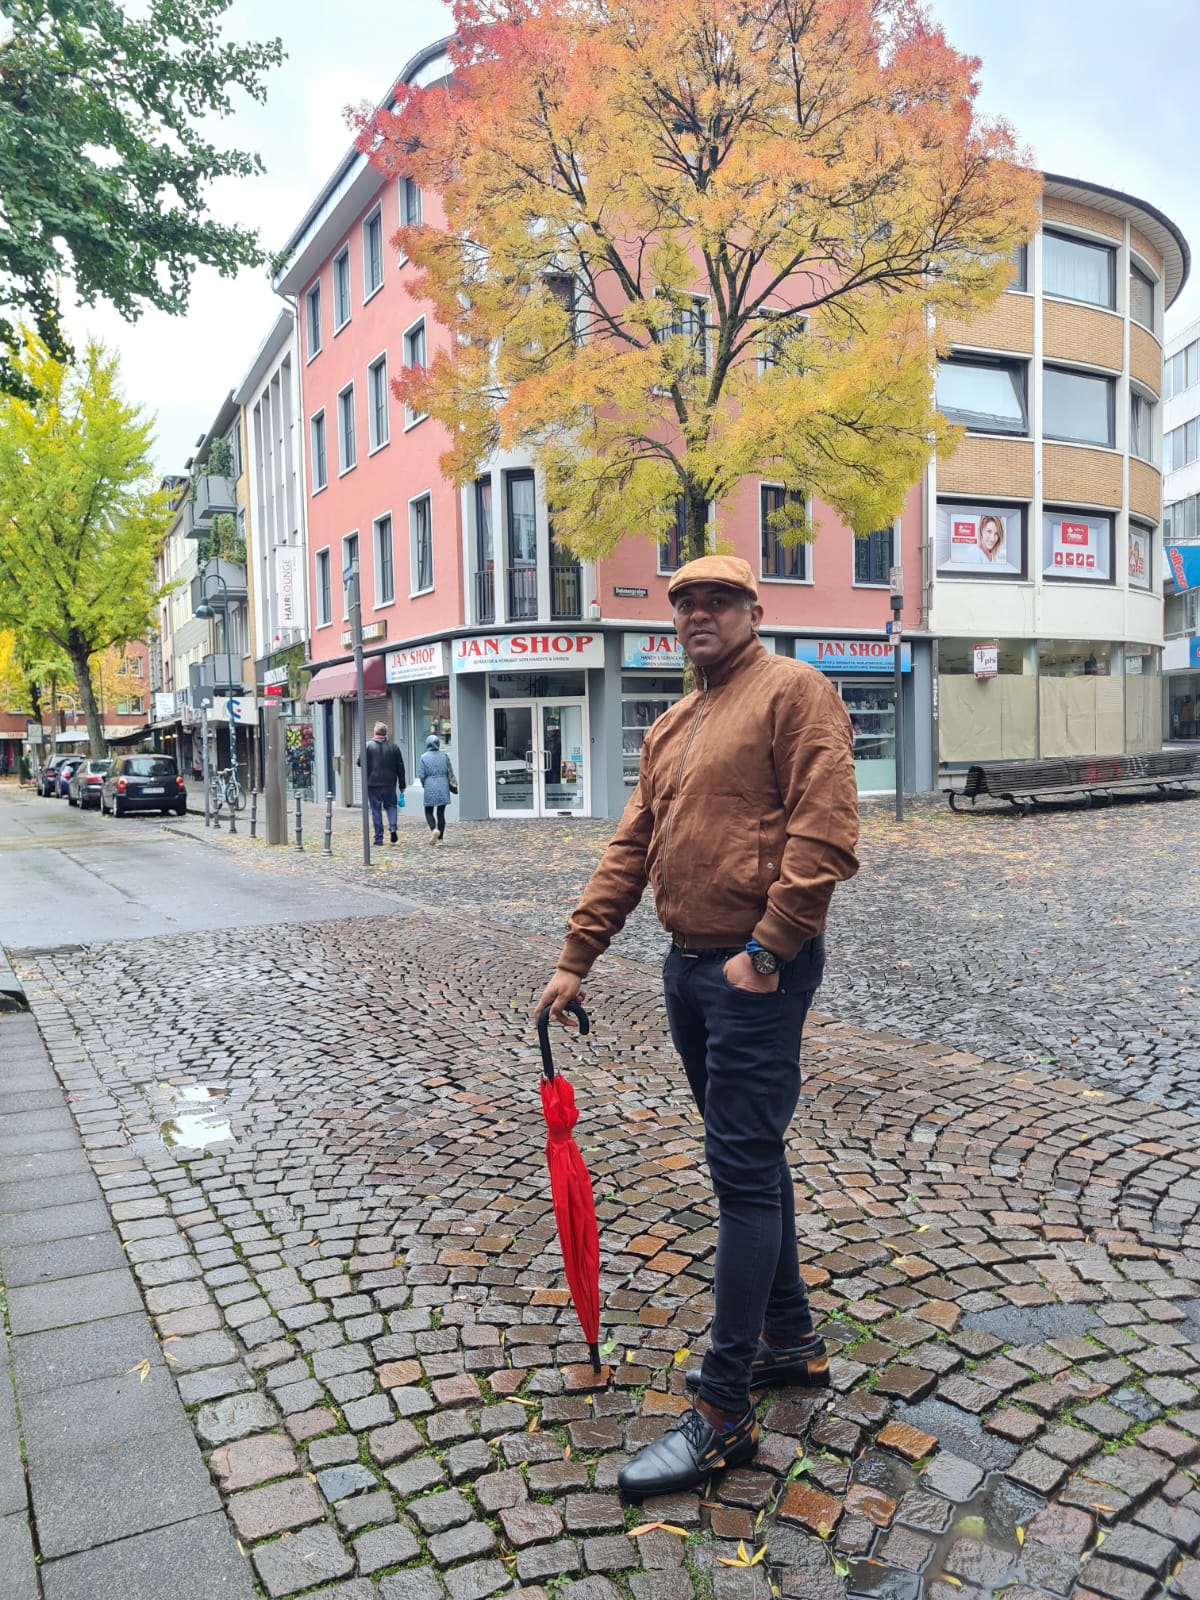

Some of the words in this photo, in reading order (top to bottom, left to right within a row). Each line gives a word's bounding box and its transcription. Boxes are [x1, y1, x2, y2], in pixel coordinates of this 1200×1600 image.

[282, 559, 292, 620] HAIRLOUNGE
[458, 639, 499, 657] JAN
[511, 636, 593, 654] SHOP
[817, 642, 845, 660] JAN
[849, 643, 893, 657] SHOP
[391, 652, 407, 668] JAN
[410, 648, 434, 665] SHOP
